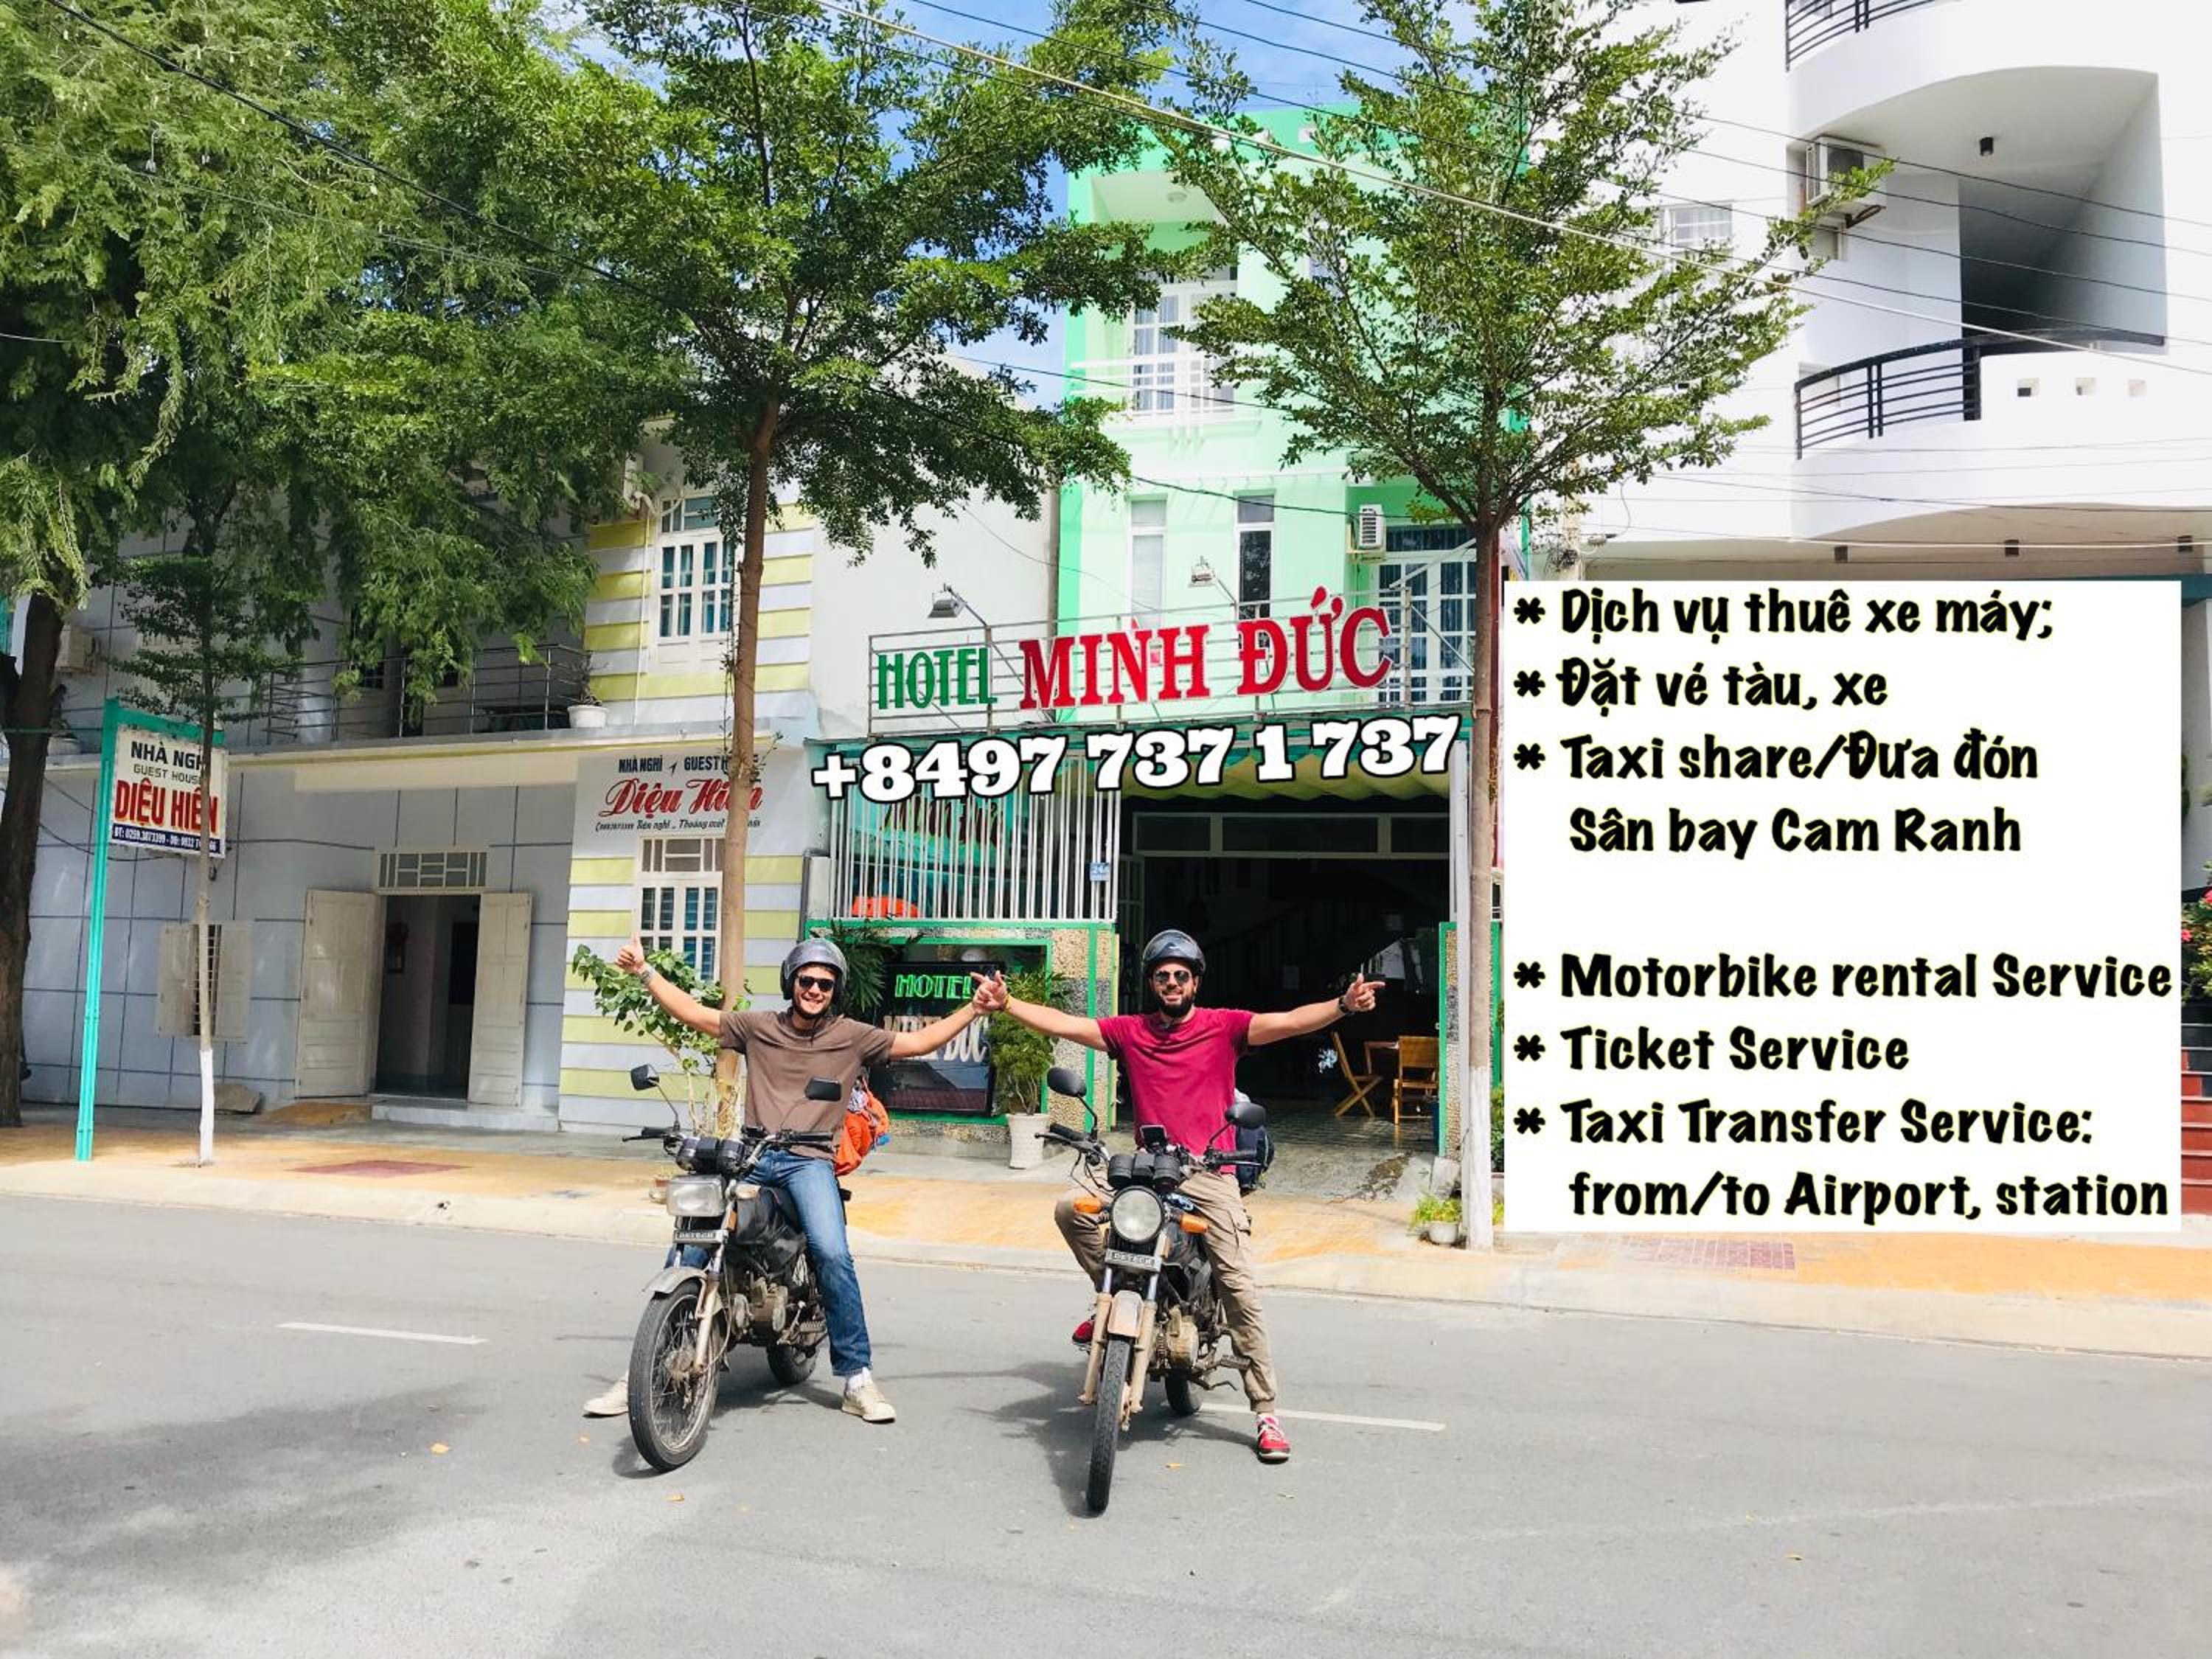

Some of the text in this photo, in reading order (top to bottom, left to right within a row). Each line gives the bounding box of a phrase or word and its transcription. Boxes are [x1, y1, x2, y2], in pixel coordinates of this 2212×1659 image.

[877, 585, 1394, 710] HOTEL MINH ĐỨC
[131, 741, 205, 771] NHÀ NGH
[684, 756, 720, 771] GUEST
[133, 764, 202, 785] GUEST HOUS
[114, 777, 166, 827] DIỆU
